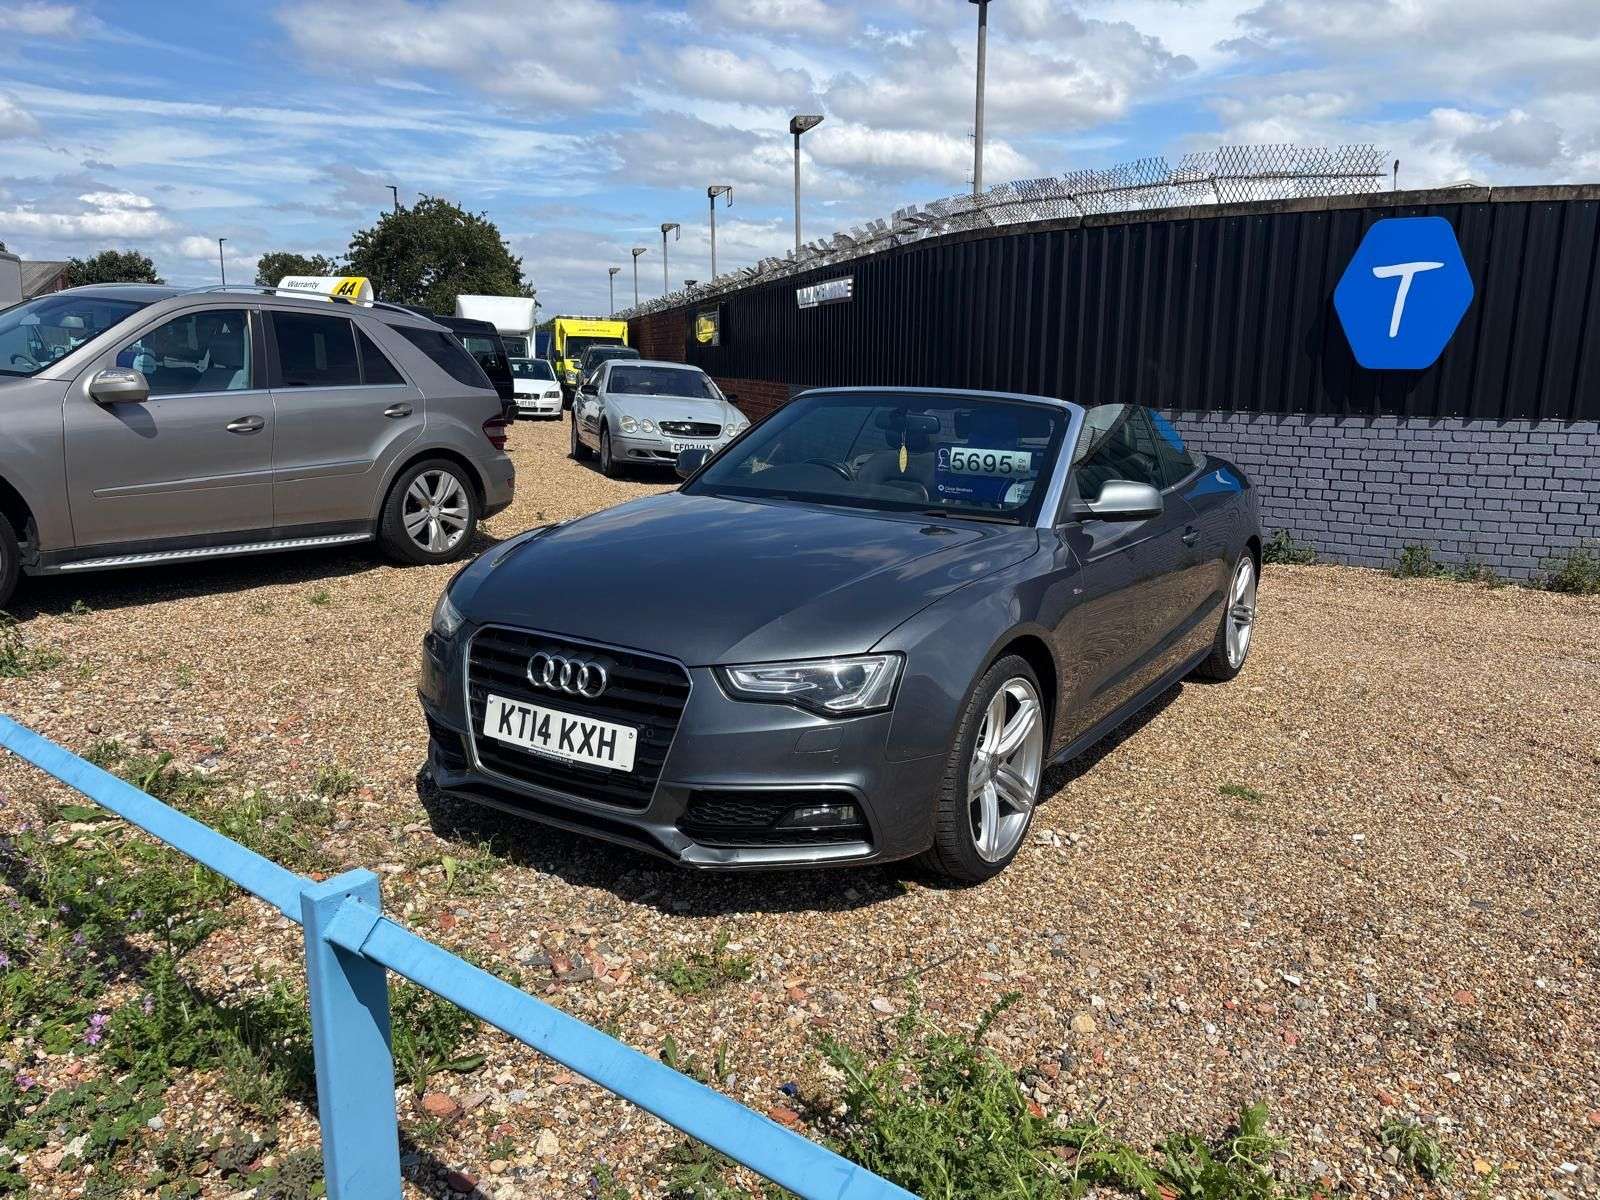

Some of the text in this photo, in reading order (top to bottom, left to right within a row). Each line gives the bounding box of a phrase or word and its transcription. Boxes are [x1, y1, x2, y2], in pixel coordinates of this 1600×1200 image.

[287, 281, 357, 296] Warranty AA
[1373, 261, 1445, 338] T
[498, 702, 617, 761] KT14 KXH
